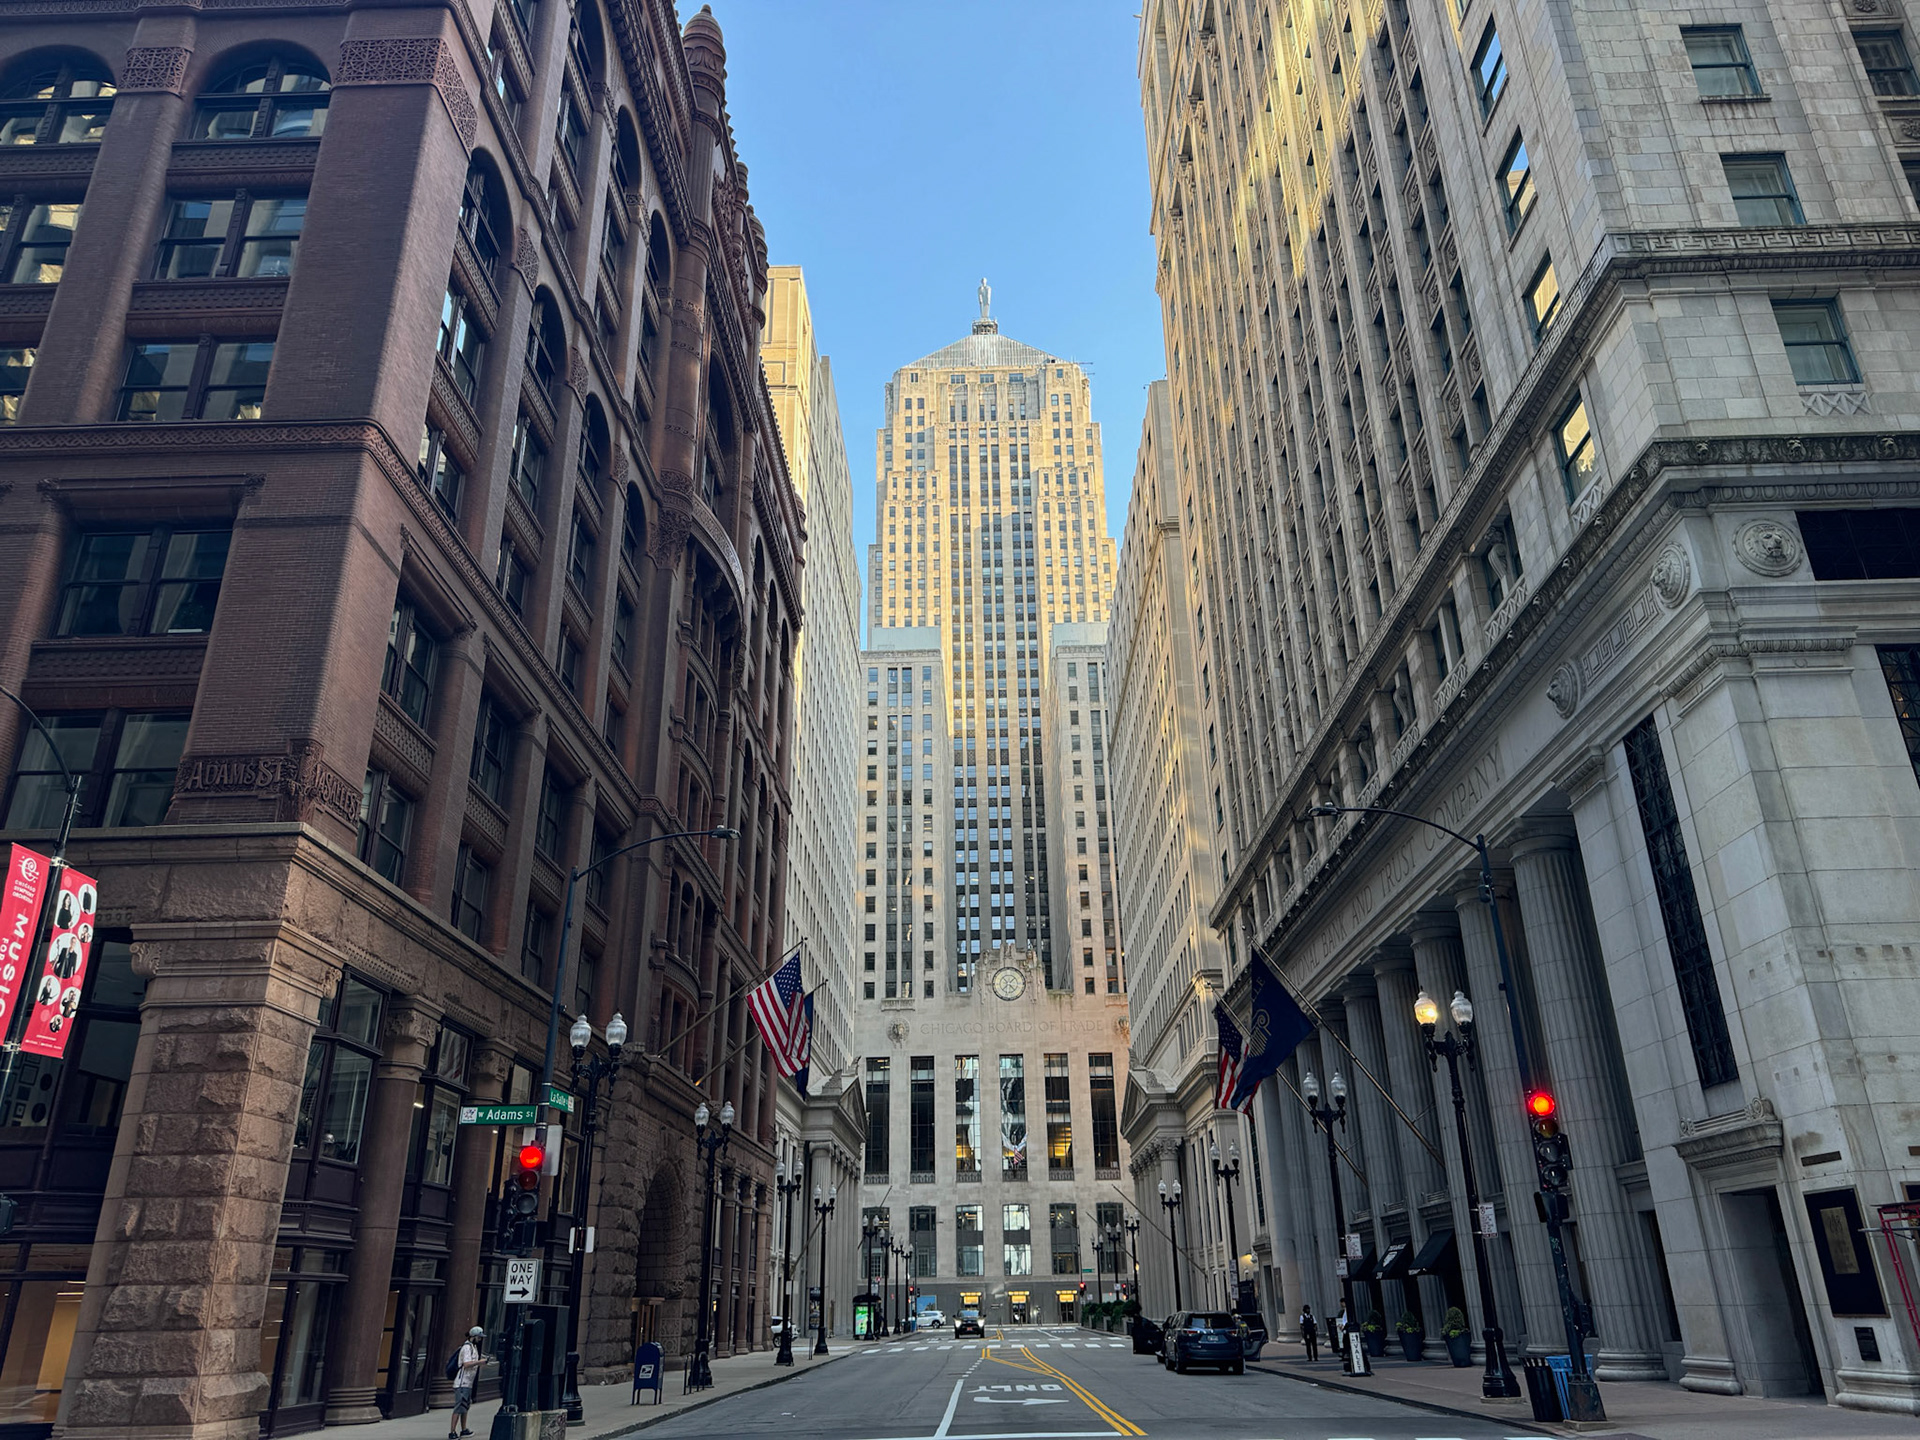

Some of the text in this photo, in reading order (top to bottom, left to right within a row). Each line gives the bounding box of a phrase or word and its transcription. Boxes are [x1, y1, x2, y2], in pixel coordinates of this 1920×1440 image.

[187, 761, 256, 790] ADAMS
[1322, 913, 1348, 958] BANK
[1352, 884, 1373, 927] AND
[1378, 835, 1416, 898] TRUST
[1422, 742, 1500, 852] COMPANY
[920, 1019, 1104, 1035] CHICAGO BOARD OF TRADE
[486, 1109, 523, 1121] Adams
[526, 1110, 534, 1118] St
[511, 1263, 534, 1273] ONE
[510, 1275, 533, 1285] WAY
[1353, 1343, 1362, 1371] VALET
[967, 1384, 1063, 1393] ONLY
